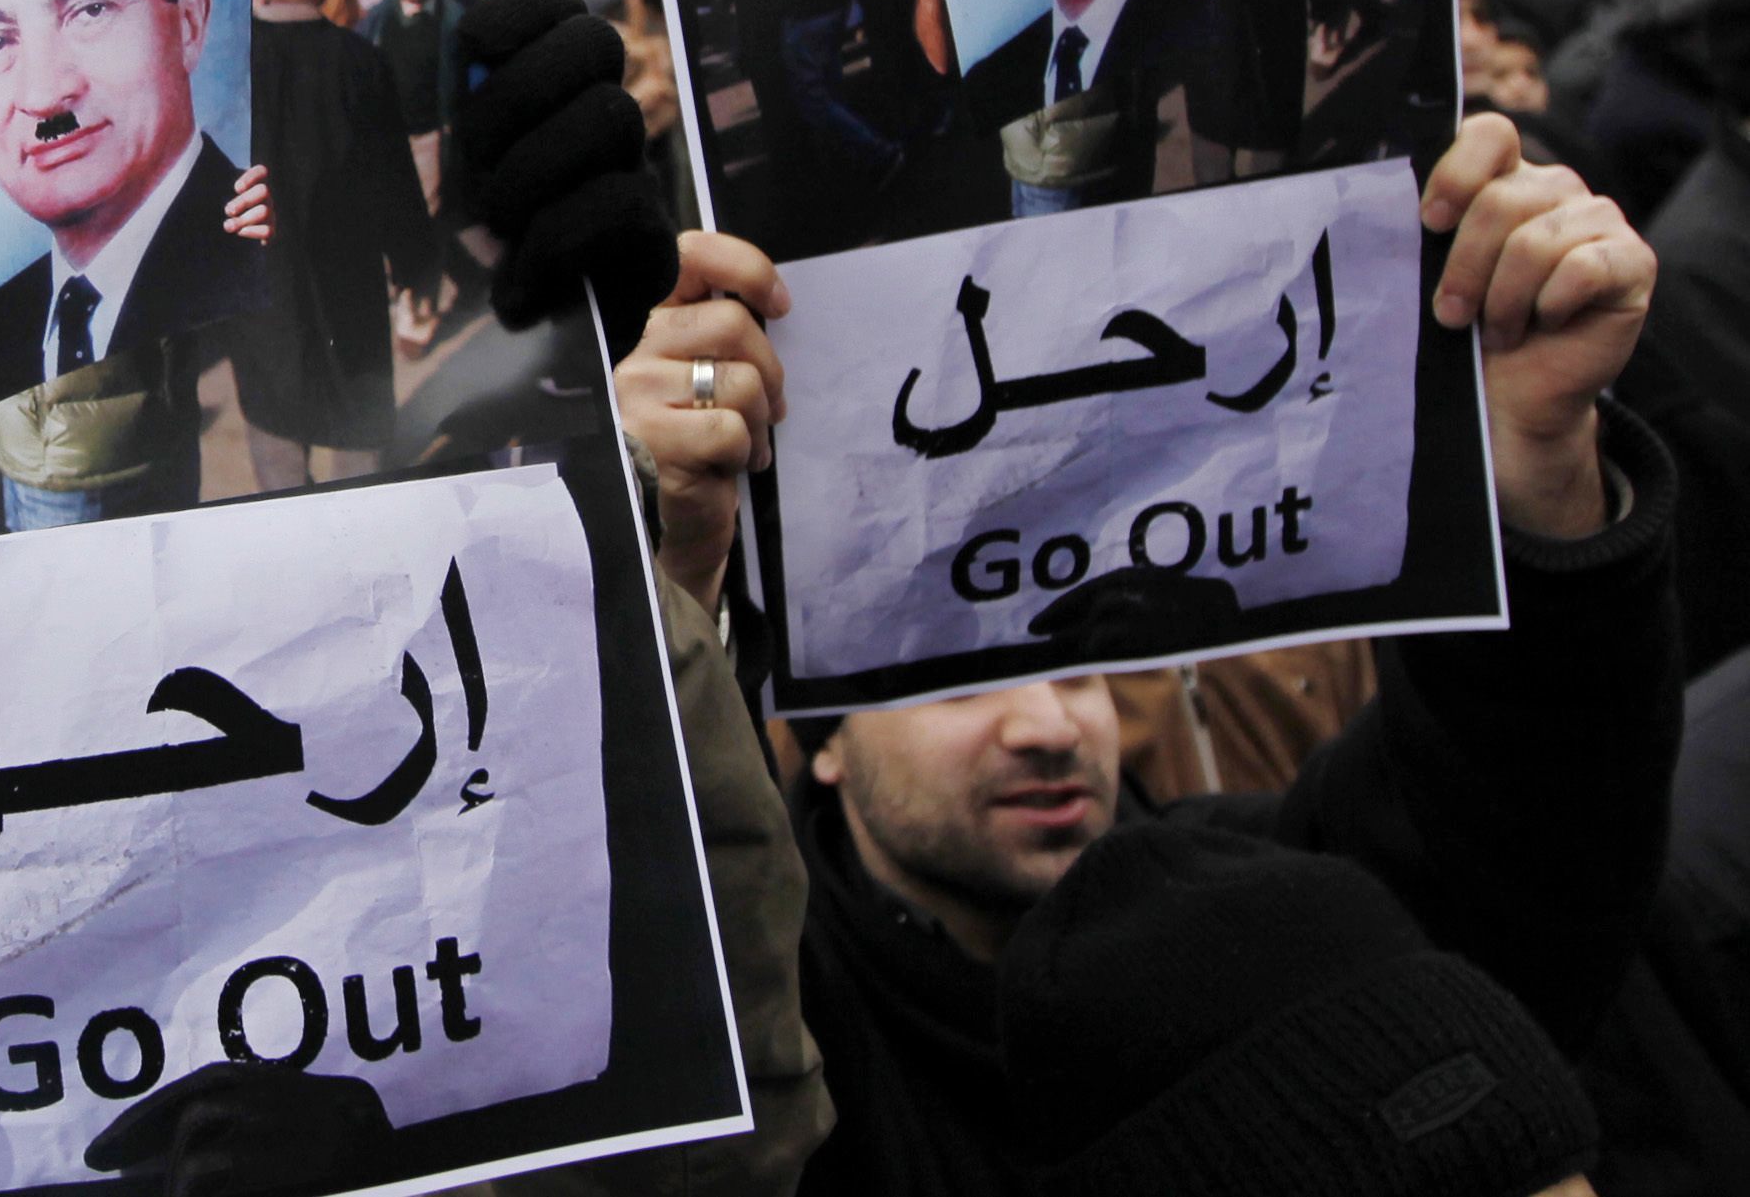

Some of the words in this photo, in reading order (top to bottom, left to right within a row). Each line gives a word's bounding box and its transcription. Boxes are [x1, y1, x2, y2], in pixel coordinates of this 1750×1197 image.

[891, 226, 1337, 460] إرحل
[951, 528, 1092, 602] Go
[1128, 486, 1314, 577] Out
[216, 935, 483, 1070] Out
